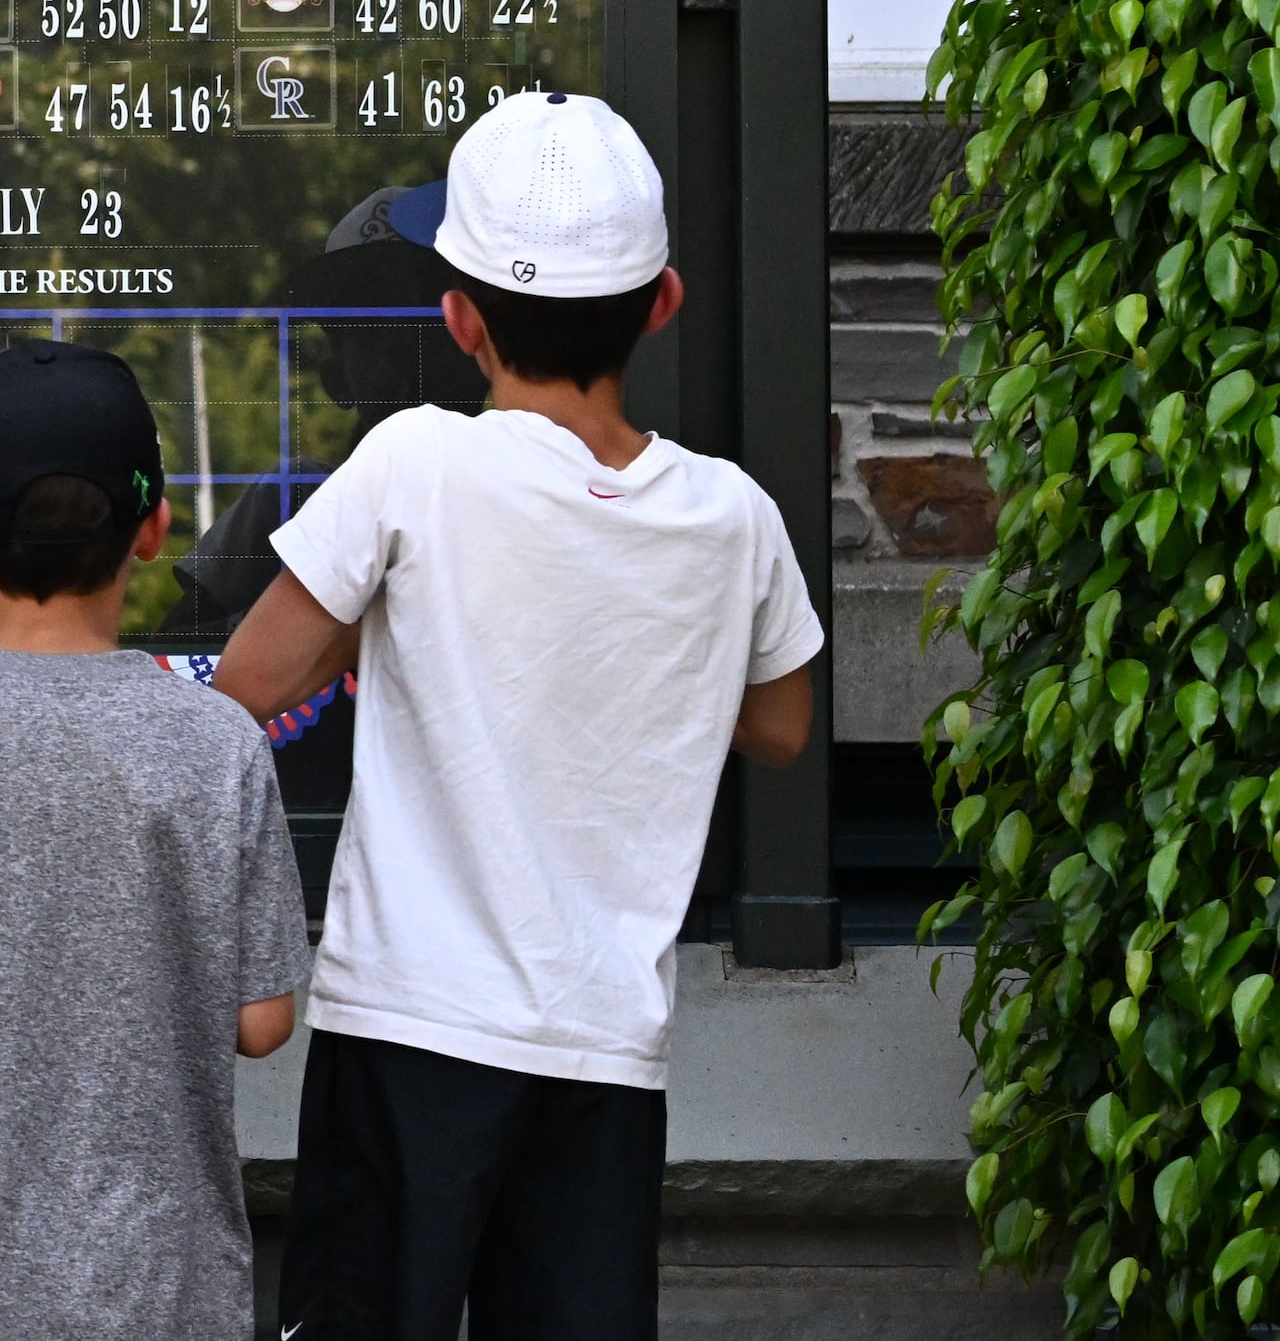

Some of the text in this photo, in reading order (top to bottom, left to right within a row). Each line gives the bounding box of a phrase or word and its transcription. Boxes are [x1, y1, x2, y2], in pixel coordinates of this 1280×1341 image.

[45, 84, 88, 132] 47
[110, 82, 153, 130] 54
[358, 71, 399, 126] 41
[424, 76, 466, 127] 63
[80, 188, 122, 238] 23
[36, 268, 173, 294] RESULTS
